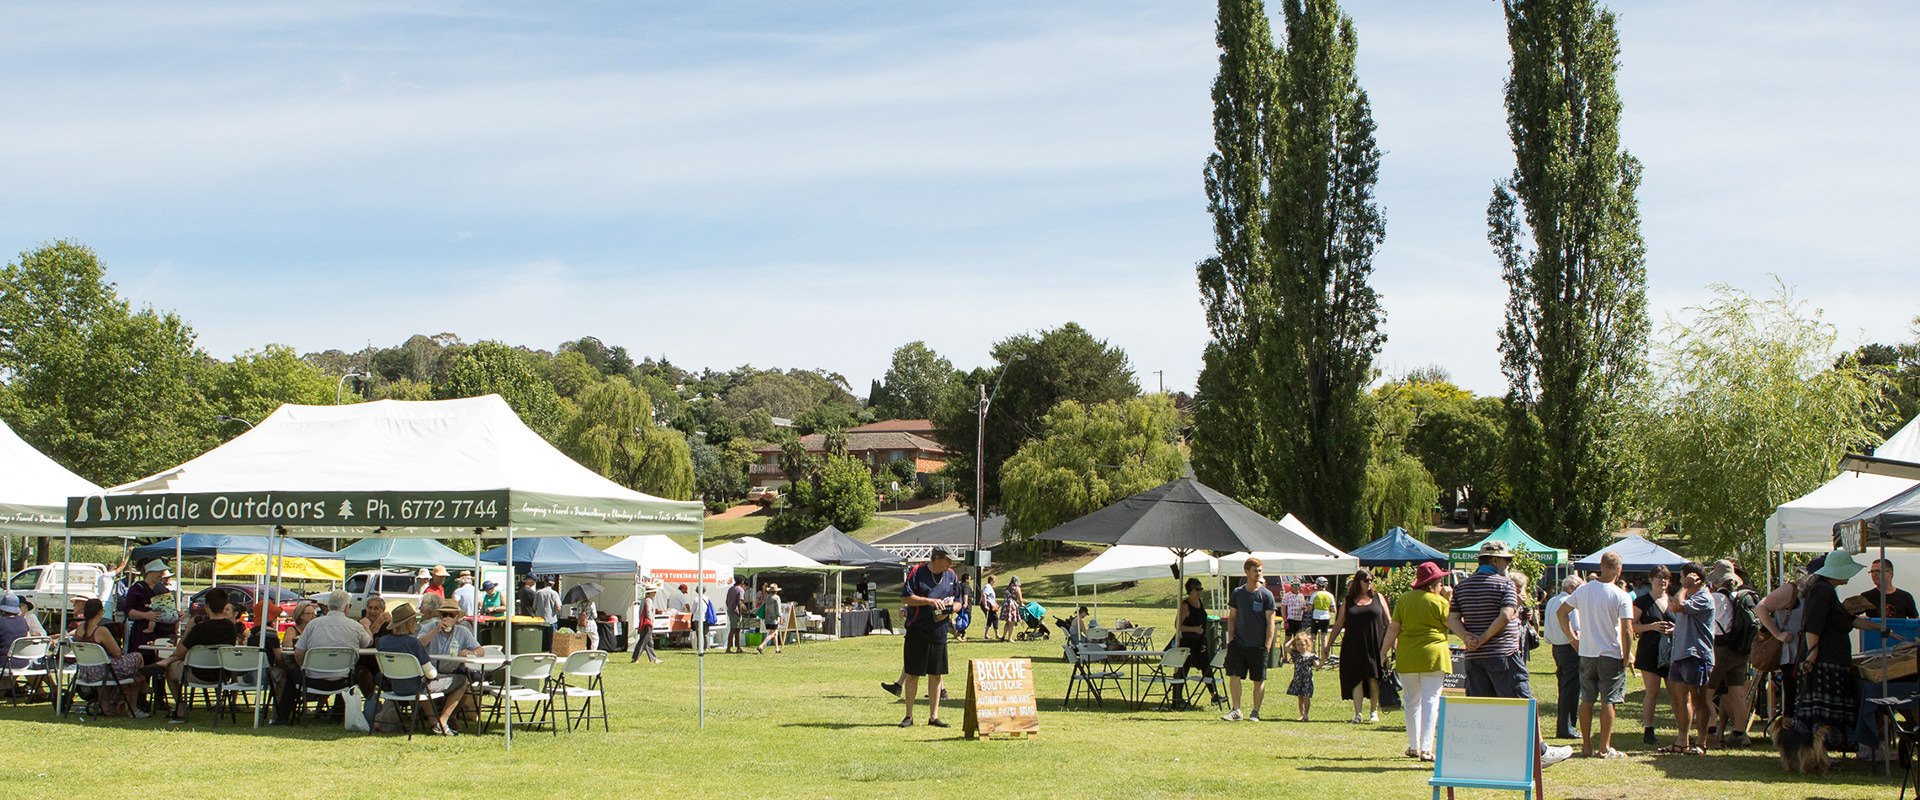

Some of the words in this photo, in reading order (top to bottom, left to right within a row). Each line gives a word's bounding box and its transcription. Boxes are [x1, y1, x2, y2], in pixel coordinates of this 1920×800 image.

[210, 494, 325, 520] Outdoors
[366, 499, 395, 519] Ph.
[401, 500, 445, 519] 6772
[451, 500, 498, 519] 7744
[976, 660, 1025, 681] BRIOCHE
[981, 680, 1024, 691] BOUTIQUE
